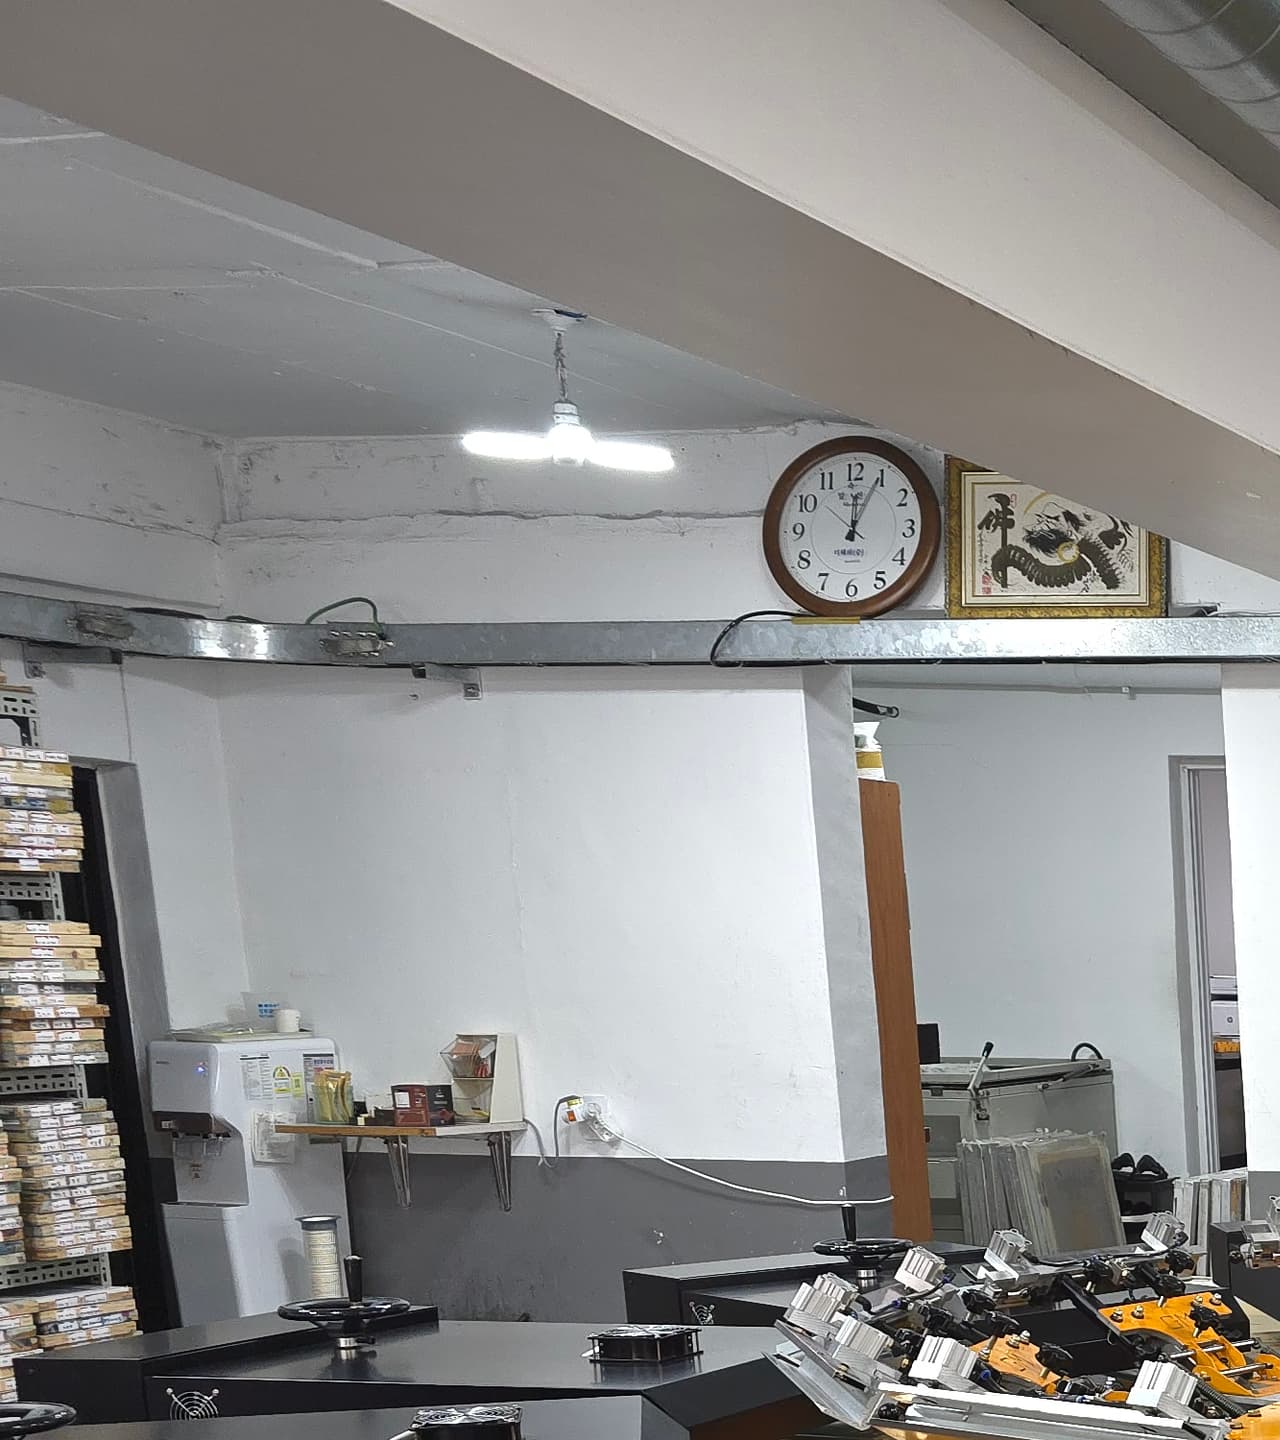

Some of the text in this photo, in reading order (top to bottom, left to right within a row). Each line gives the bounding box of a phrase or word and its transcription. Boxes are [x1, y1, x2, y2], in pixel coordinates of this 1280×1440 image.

[820, 471, 834, 490] 11
[847, 462, 864, 481] 12
[879, 469, 885, 487] 1
[798, 494, 818, 513] 10
[896, 488, 908, 507] 2
[792, 522, 805, 541] 9
[902, 519, 915, 538] 3
[797, 550, 811, 569] 8
[892, 547, 906, 566] 4
[817, 572, 830, 591] 7
[846, 578, 858, 597] 6
[874, 571, 886, 589] 5
